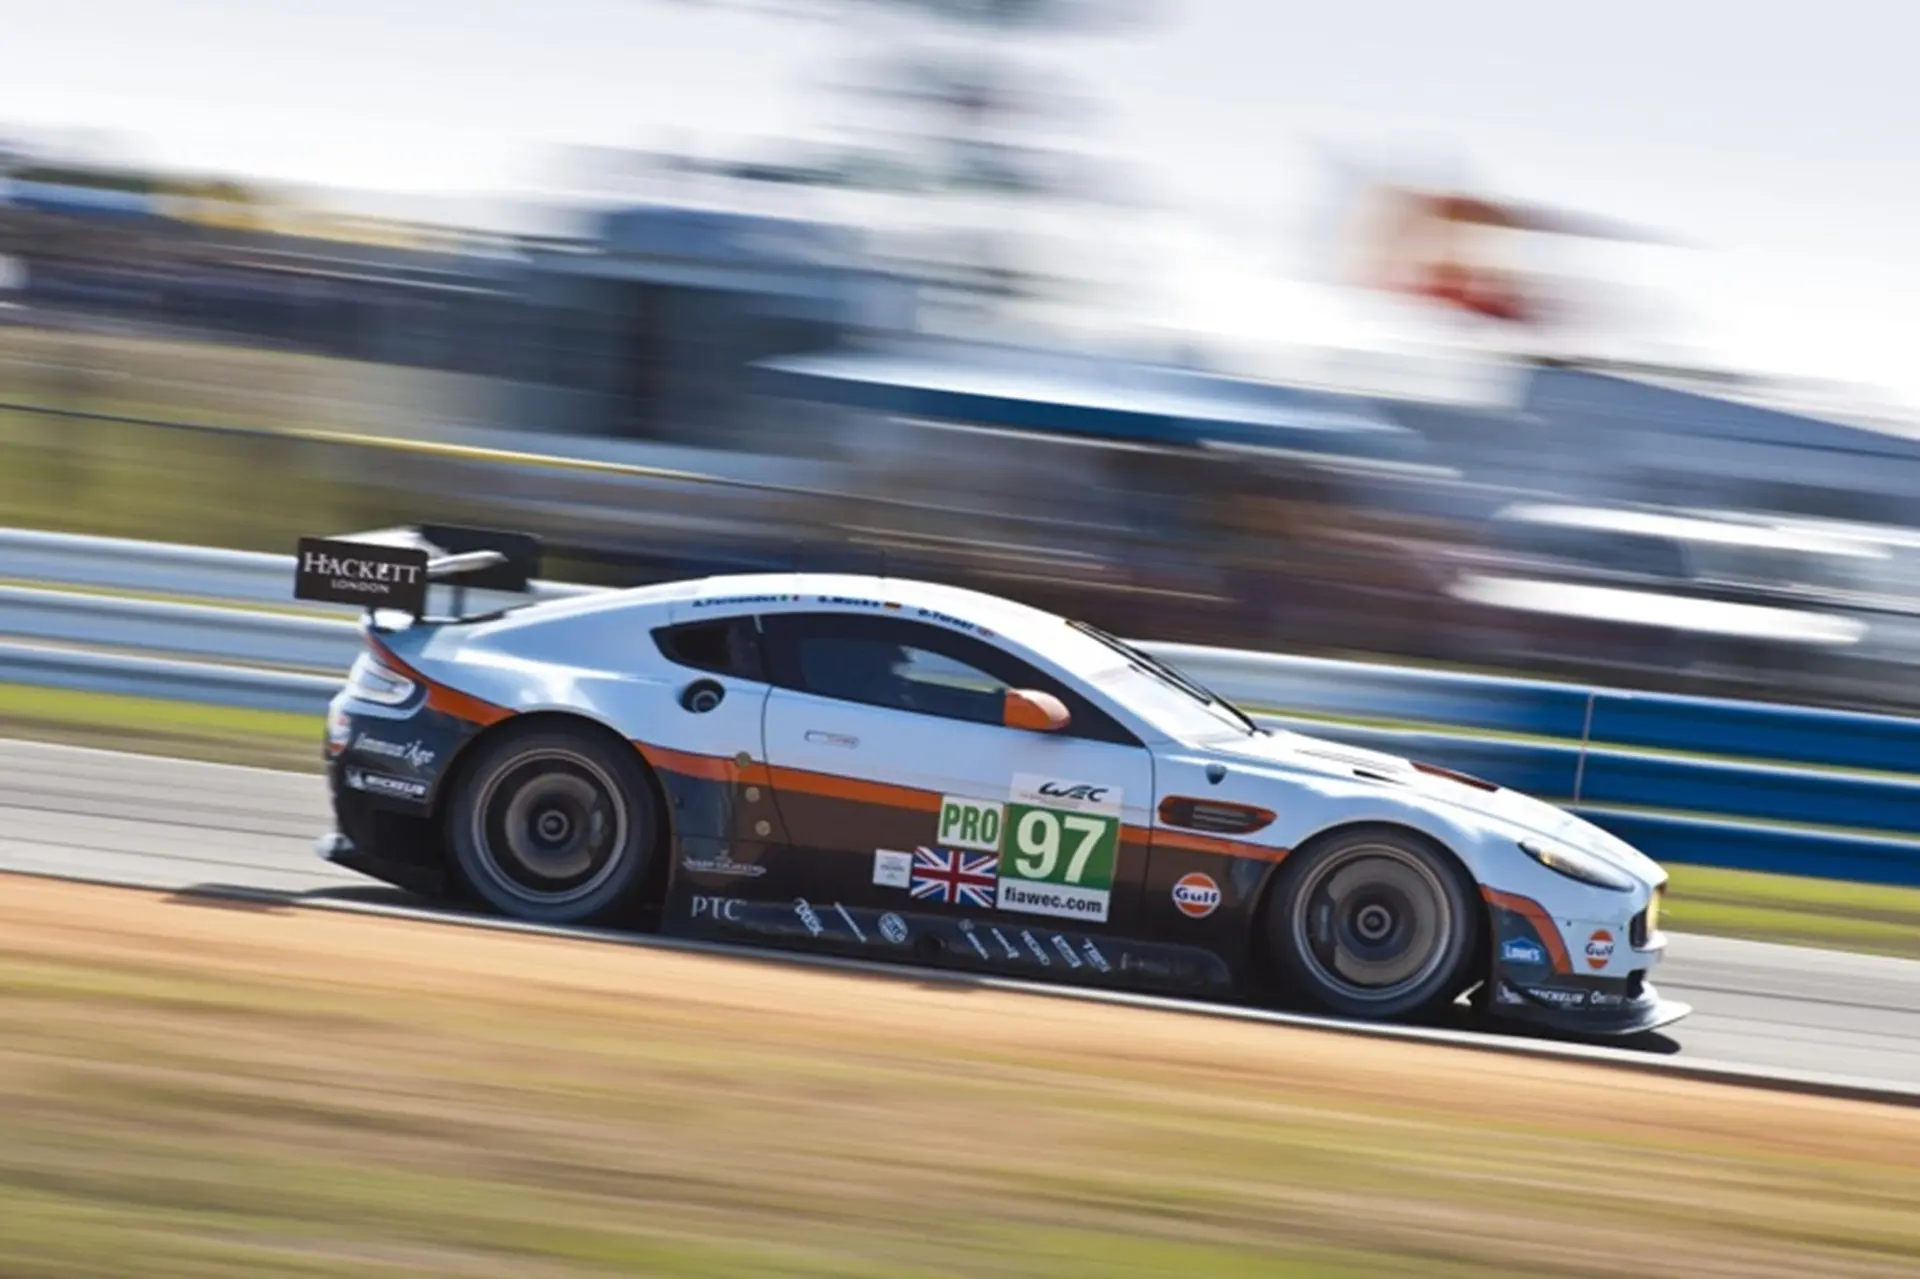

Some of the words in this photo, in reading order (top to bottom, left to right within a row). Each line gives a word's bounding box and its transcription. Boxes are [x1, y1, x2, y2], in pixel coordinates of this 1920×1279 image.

[303, 552, 421, 584] HACKETT
[331, 579, 390, 594] LONDON
[1039, 782, 1109, 802] WEC
[941, 803, 999, 844] PRO
[1015, 809, 1107, 885] 97
[1004, 886, 1103, 914] fiawec.com
[1175, 887, 1218, 904] Gulf
[691, 896, 747, 921] PTC
[1585, 942, 1615, 957] Gulf
